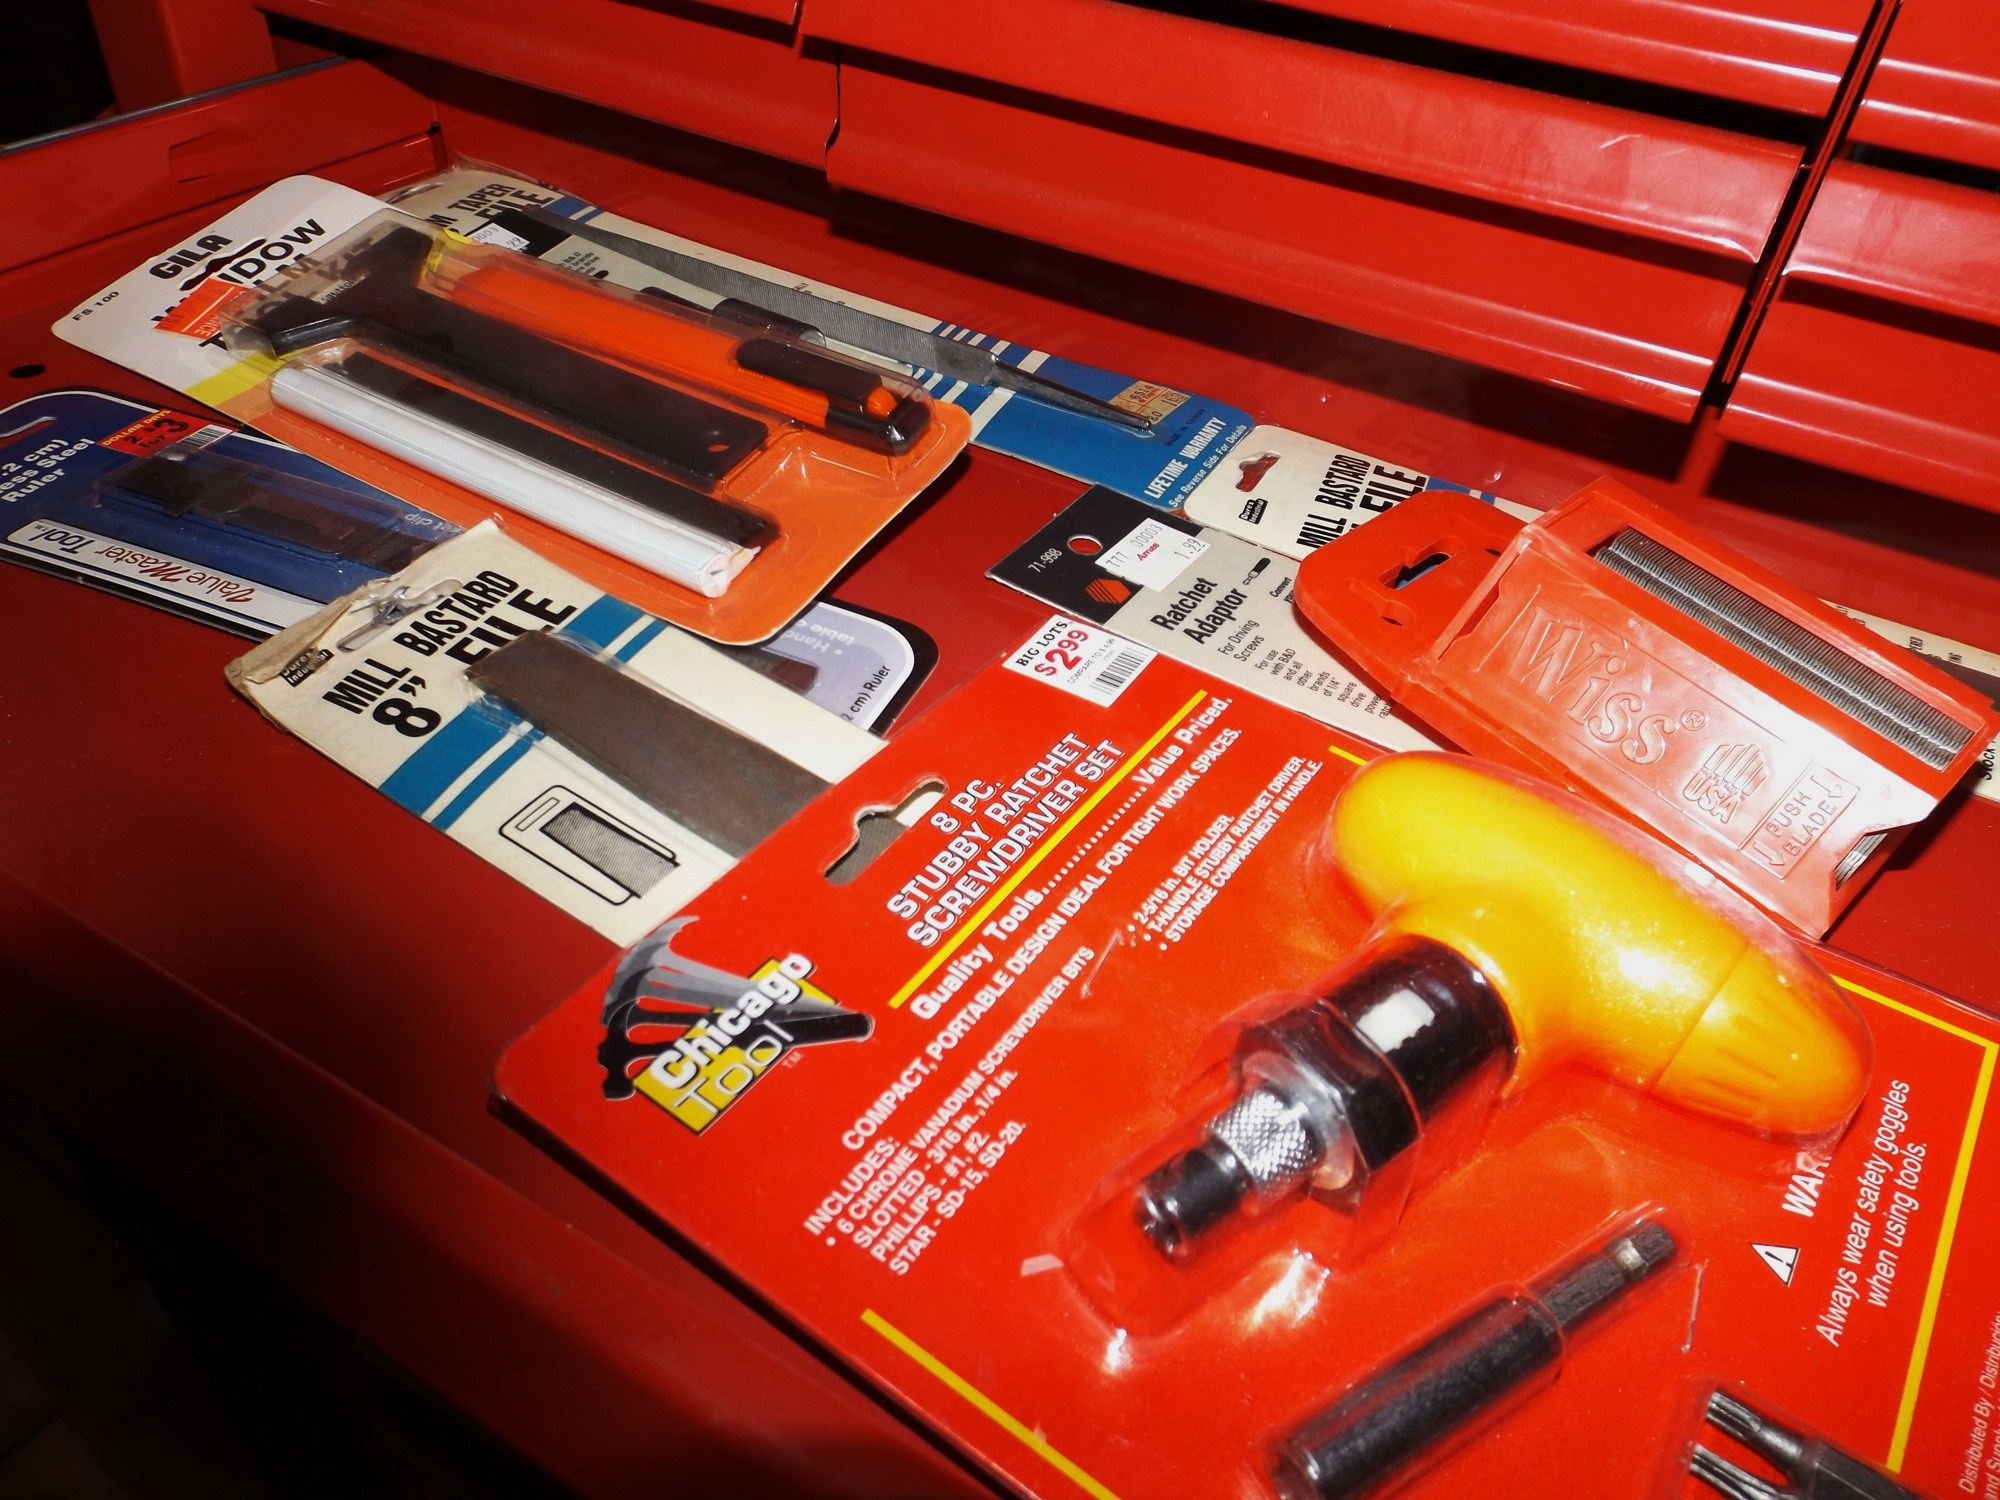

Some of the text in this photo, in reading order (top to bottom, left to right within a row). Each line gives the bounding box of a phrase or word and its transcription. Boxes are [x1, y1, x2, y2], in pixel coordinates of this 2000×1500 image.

[447, 183, 517, 213] TAPER
[474, 189, 557, 219] FILE
[149, 234, 233, 280] GILA
[72, 290, 120, 322] FS 100
[24, 439, 70, 463] cm)
[36, 437, 97, 468] Steel
[1144, 416, 1227, 500] LIFETIME WARRANTY
[1168, 424, 1248, 508] See Reverse Side For Details
[1, 468, 66, 503] Ruler
[1296, 454, 1371, 550] MILL BASTARD
[1359, 465, 1428, 514] FILE
[28, 527, 96, 555] Tool
[1027, 547, 1063, 573] 71-998
[1105, 524, 1164, 569] 777 00003
[1173, 537, 1207, 561] 1.99
[445, 588, 579, 667] FILE
[1150, 577, 1219, 632] Ratchet
[1183, 586, 1249, 646] Adaptor
[322, 570, 520, 716] MILL BASTARD
[1015, 620, 1069, 668] BIG LOTS
[1217, 619, 1261, 657] For Driving
[1233, 634, 1266, 663] Screws
[1255, 649, 1280, 671] For use
[850, 692, 873, 714] cm)
[863, 664, 892, 693] Ruler
[1269, 661, 1284, 677] with
[1283, 667, 1297, 681] and
[1296, 669, 1314, 687] other
[1309, 670, 1331, 692] brands
[1322, 685, 1333, 698] of
[1337, 681, 1358, 704] square
[1508, 606, 1681, 766] Wiss
[1350, 692, 1367, 709] drive
[929, 778, 1004, 834] 8 PC.
[1682, 771, 1741, 825] USA
[1765, 790, 1812, 838] PUSH
[886, 732, 1090, 921] STUBBY RATCHET
[906, 739, 1126, 949] SCREWDRIVER SET
[1147, 755, 1308, 934] T-HANDLE STUBBY RATCHET DRIVER.
[1164, 759, 1325, 944] STORAGE COMPARTMENT IN HANDLE.
[1782, 799, 1839, 857] BLADE
[909, 942, 995, 1020] Quality
[1174, 696, 1234, 745] Priced.
[1133, 814, 1237, 926] 2-5/16 in. BIT HOLDER.
[841, 726, 1243, 1151] COMPACT, PORTABLE DESIGN IDEAL FOR TIGHT WORK SPACES.
[649, 953, 815, 1090] Chicago
[836, 945, 1096, 1235] 6 CHROME VANADIUM SCREWDRIVER BITS
[852, 1167, 927, 1249] SLOTTED
[926, 1127, 963, 1165] 3/16
[993, 1068, 1020, 1089] in.
[803, 1136, 902, 1236] INCLUDES:
[869, 1182, 944, 1263] PHILLIPS
[943, 1154, 974, 1179] #1,
[888, 1120, 1028, 1277] STAR SD-15, SD-20.
[1815, 1079, 1911, 1348] Always wear safety goggles
[1865, 1141, 1929, 1309] when using tools.
[1957, 1414, 1988, 1495] Distributed
[1973, 1396, 1996, 1419] By
